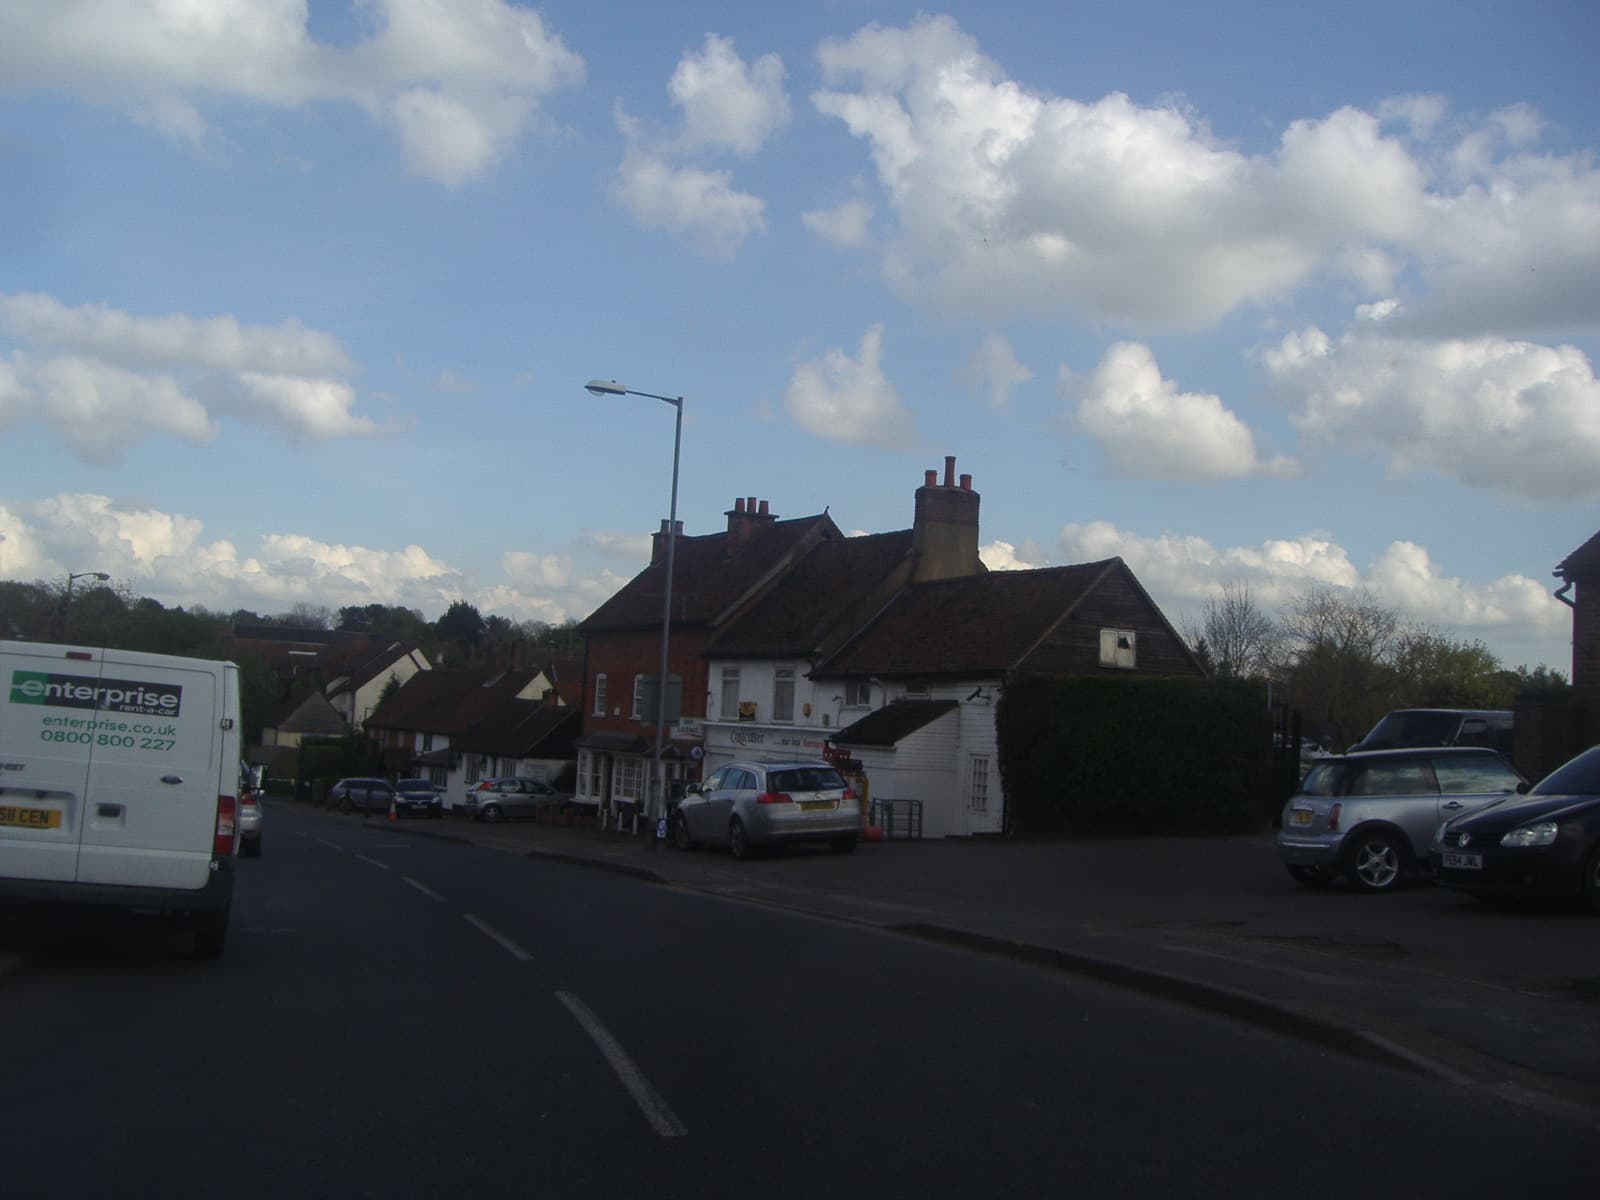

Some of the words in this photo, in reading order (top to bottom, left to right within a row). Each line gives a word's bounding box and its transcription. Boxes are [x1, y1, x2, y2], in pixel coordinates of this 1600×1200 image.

[22, 680, 178, 707] enterprise
[119, 704, 176, 717] rent-a-car
[42, 716, 177, 737] enterprise.co.uk
[40, 730, 92, 745] 0800
[97, 733, 135, 748] 800
[140, 738, 177, 752] 227
[19, 809, 49, 825] CEN
